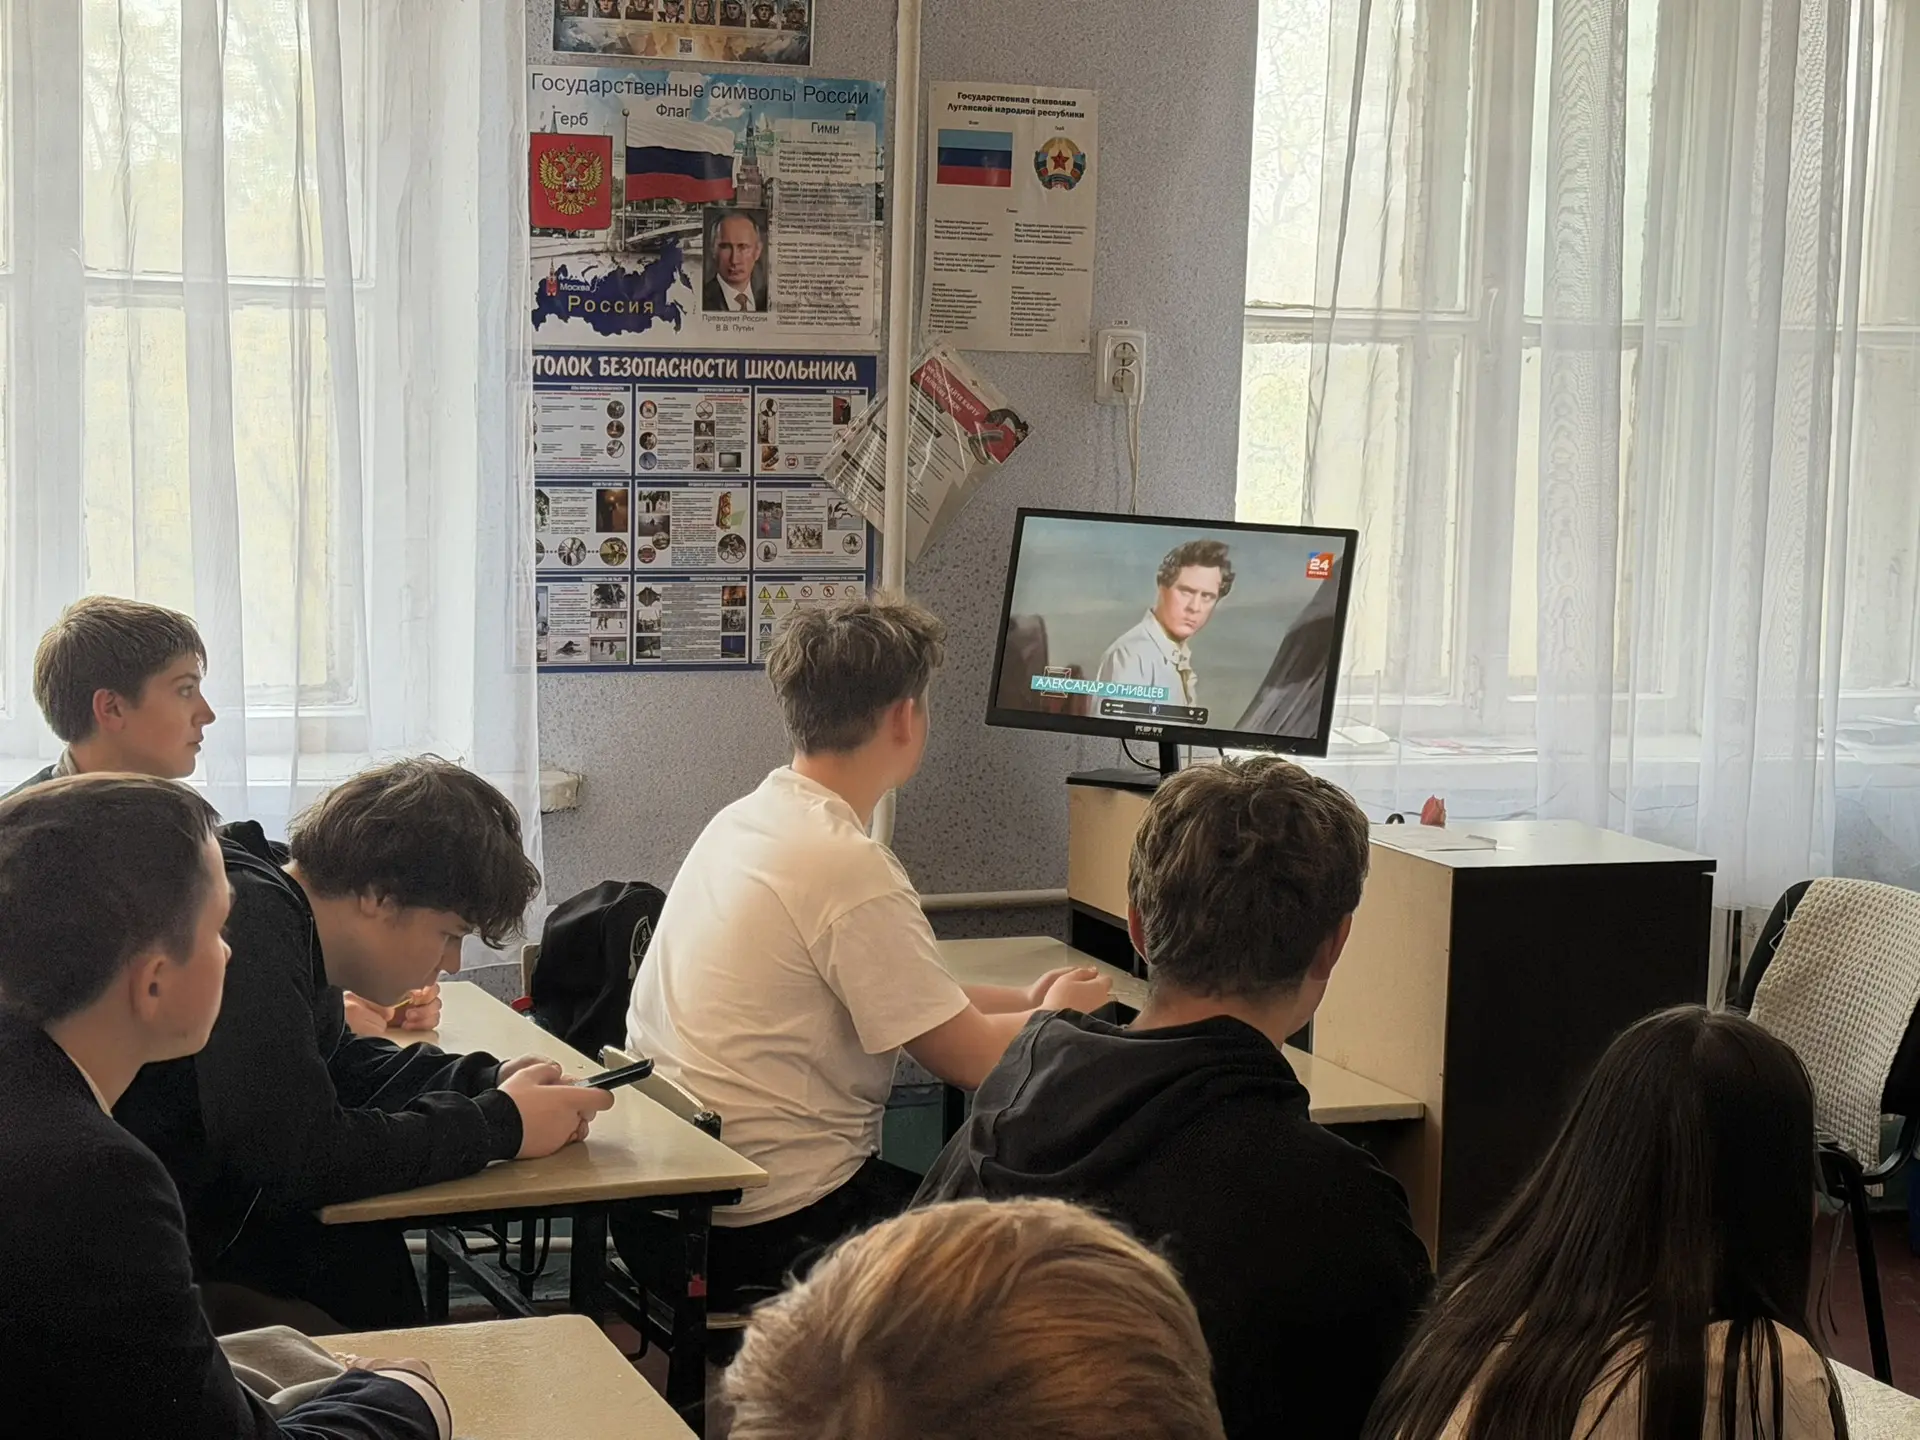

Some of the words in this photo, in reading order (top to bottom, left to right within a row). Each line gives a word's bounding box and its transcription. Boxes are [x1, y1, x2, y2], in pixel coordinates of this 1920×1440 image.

[532, 73, 704, 97] Государственные
[711, 84, 796, 102] символы
[803, 85, 869, 104] России
[553, 110, 589, 128] Герб
[656, 103, 691, 117] Флаг
[811, 121, 840, 135] Гимн
[559, 282, 590, 292] Москва
[567, 296, 654, 314] Россия
[598, 356, 738, 380] БЕЗОПАСНОСТИ
[744, 359, 857, 382] ШКОЛЬНИКА
[1309, 558, 1329, 571] 24
[1036, 678, 1104, 693] АЛЕКСАНДР
[1106, 683, 1164, 698] ОГНИВЦЕВ
